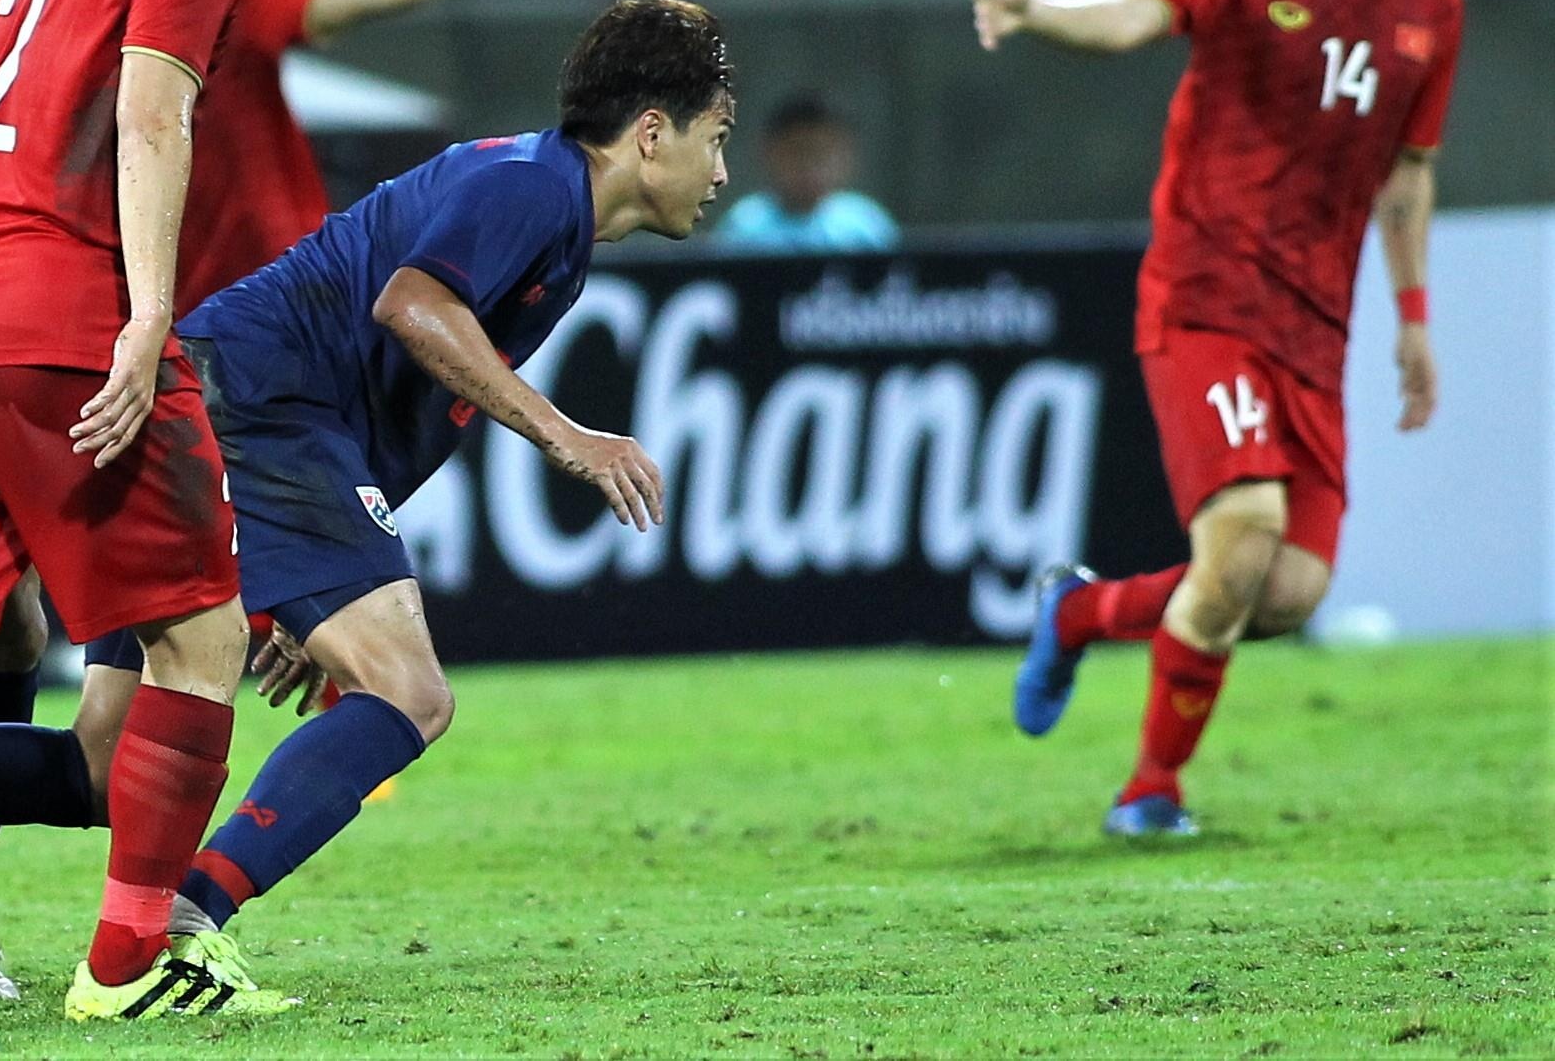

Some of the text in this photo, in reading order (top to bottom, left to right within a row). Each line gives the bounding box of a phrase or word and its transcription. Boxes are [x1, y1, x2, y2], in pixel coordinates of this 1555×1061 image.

[1320, 36, 1380, 116] 14
[1205, 373, 1269, 448] 14
[484, 273, 1103, 639] Chang
